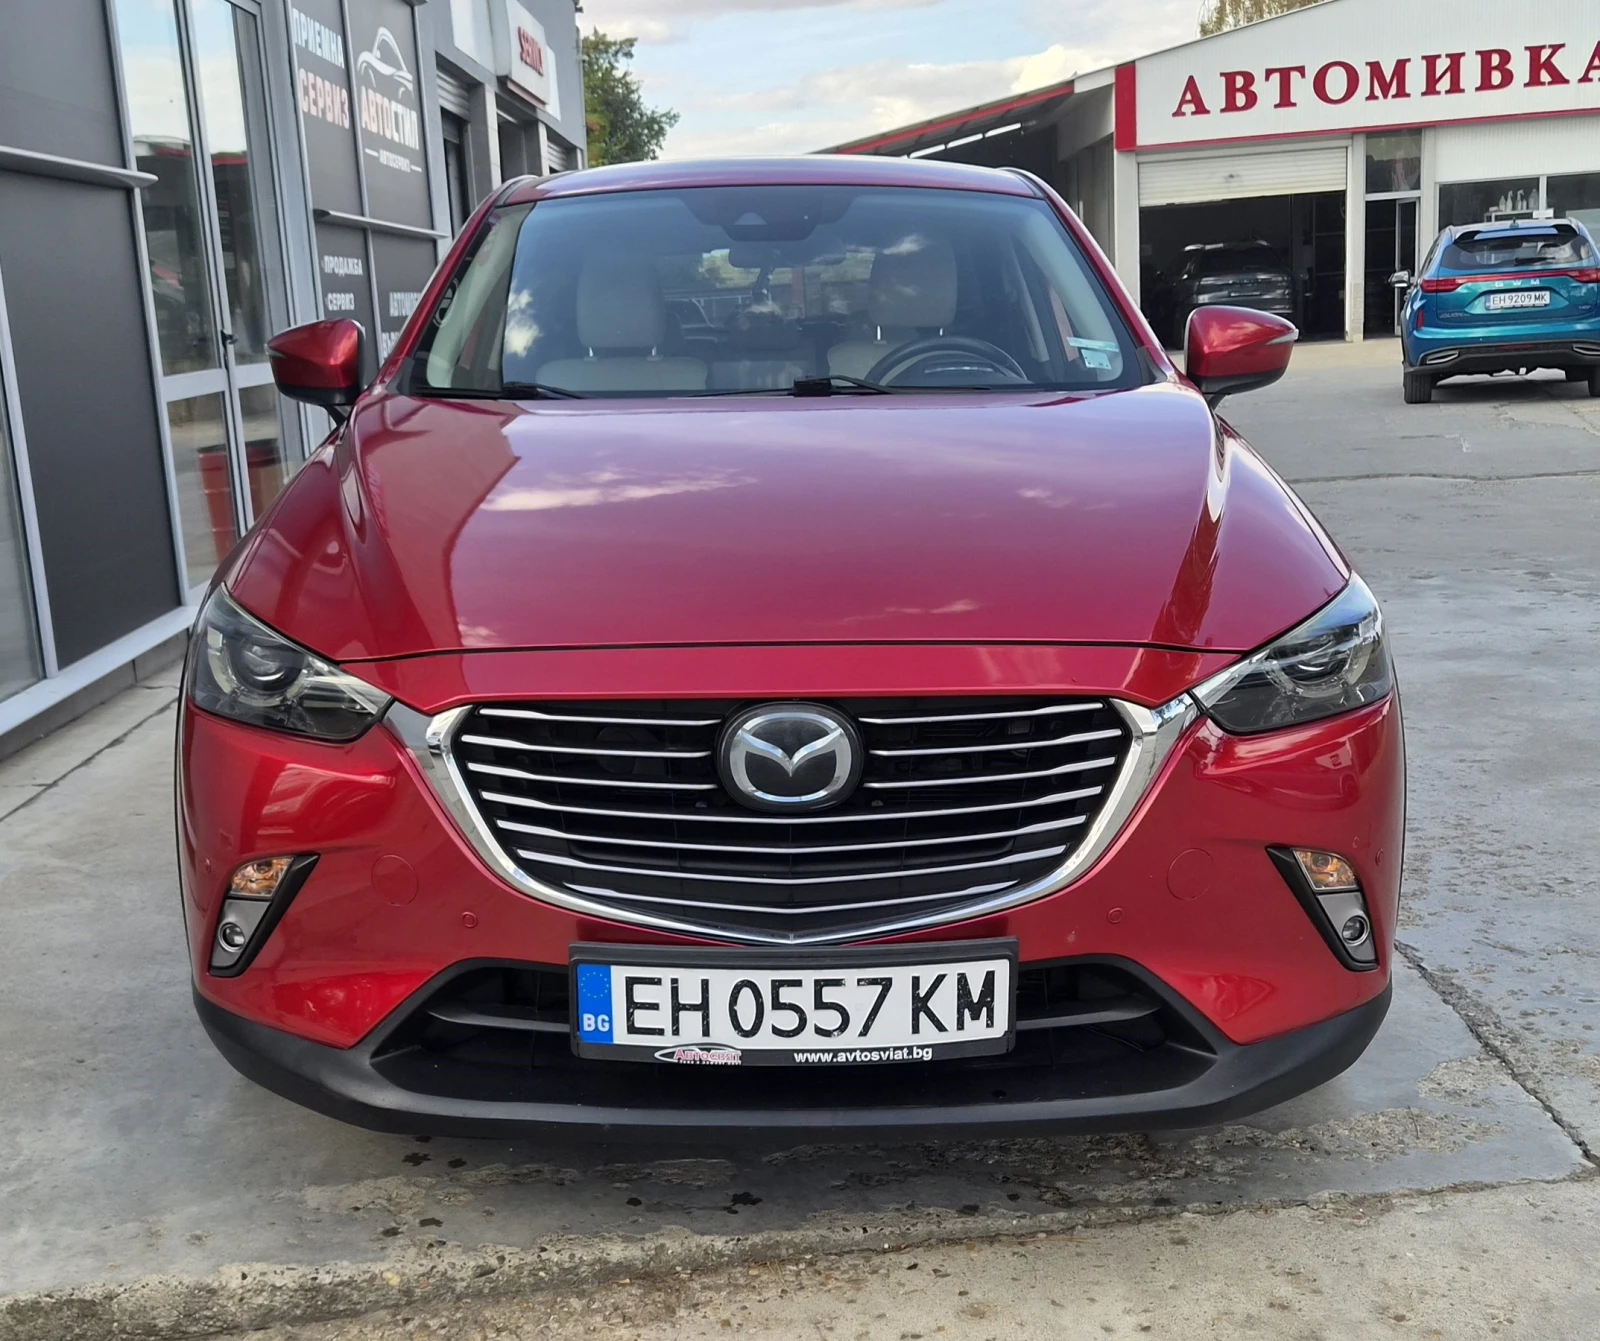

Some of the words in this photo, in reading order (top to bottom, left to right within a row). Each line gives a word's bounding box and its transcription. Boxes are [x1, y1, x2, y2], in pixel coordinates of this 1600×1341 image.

[292, 7, 345, 69] ПРИЕМНА
[299, 67, 350, 129] СЕРВИЗ
[324, 255, 363, 277] ПРОДАЖБА
[327, 292, 355, 311] СЕРВИЗ
[1492, 295, 1506, 305] EH
[1508, 293, 1532, 304] 9209
[1534, 293, 1547, 302] MK
[624, 976, 711, 1038] EH
[727, 977, 894, 1038] 0557
[910, 970, 996, 1034] KM
[582, 1014, 610, 1032] BG
[794, 1047, 933, 1062] www.avtosviat.bg
